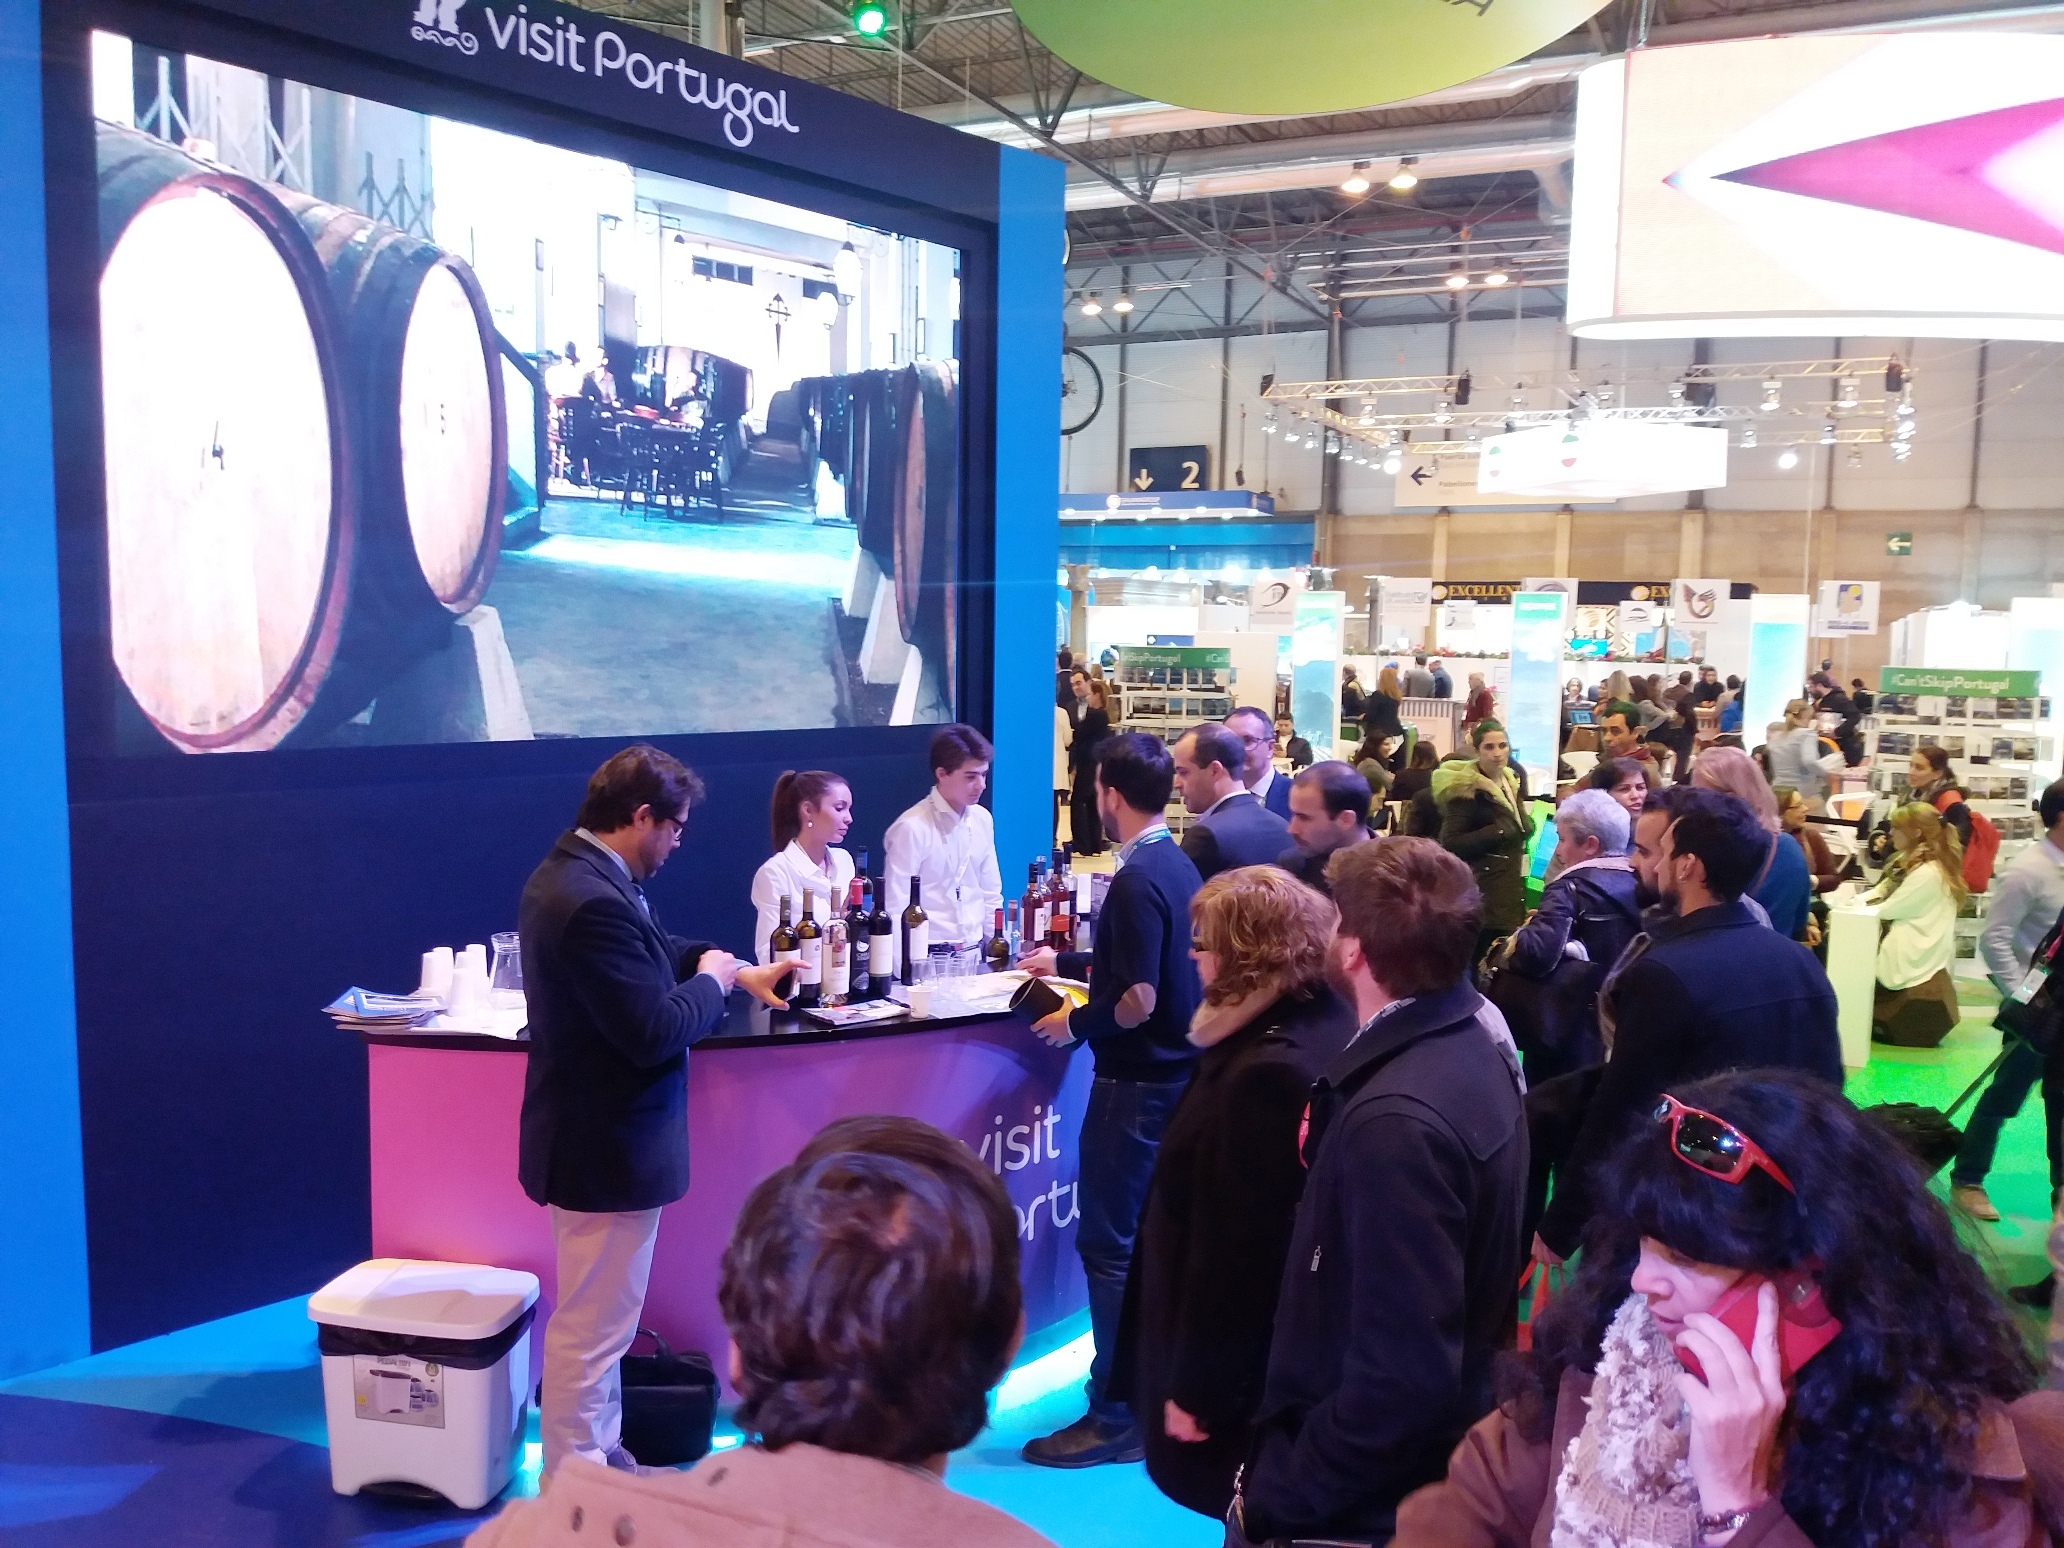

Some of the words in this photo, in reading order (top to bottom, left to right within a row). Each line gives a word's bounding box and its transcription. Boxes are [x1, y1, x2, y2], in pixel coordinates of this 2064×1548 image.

[484, 5, 587, 74] visit
[593, 31, 801, 149] Portugal
[1180, 461, 1201, 490] 2
